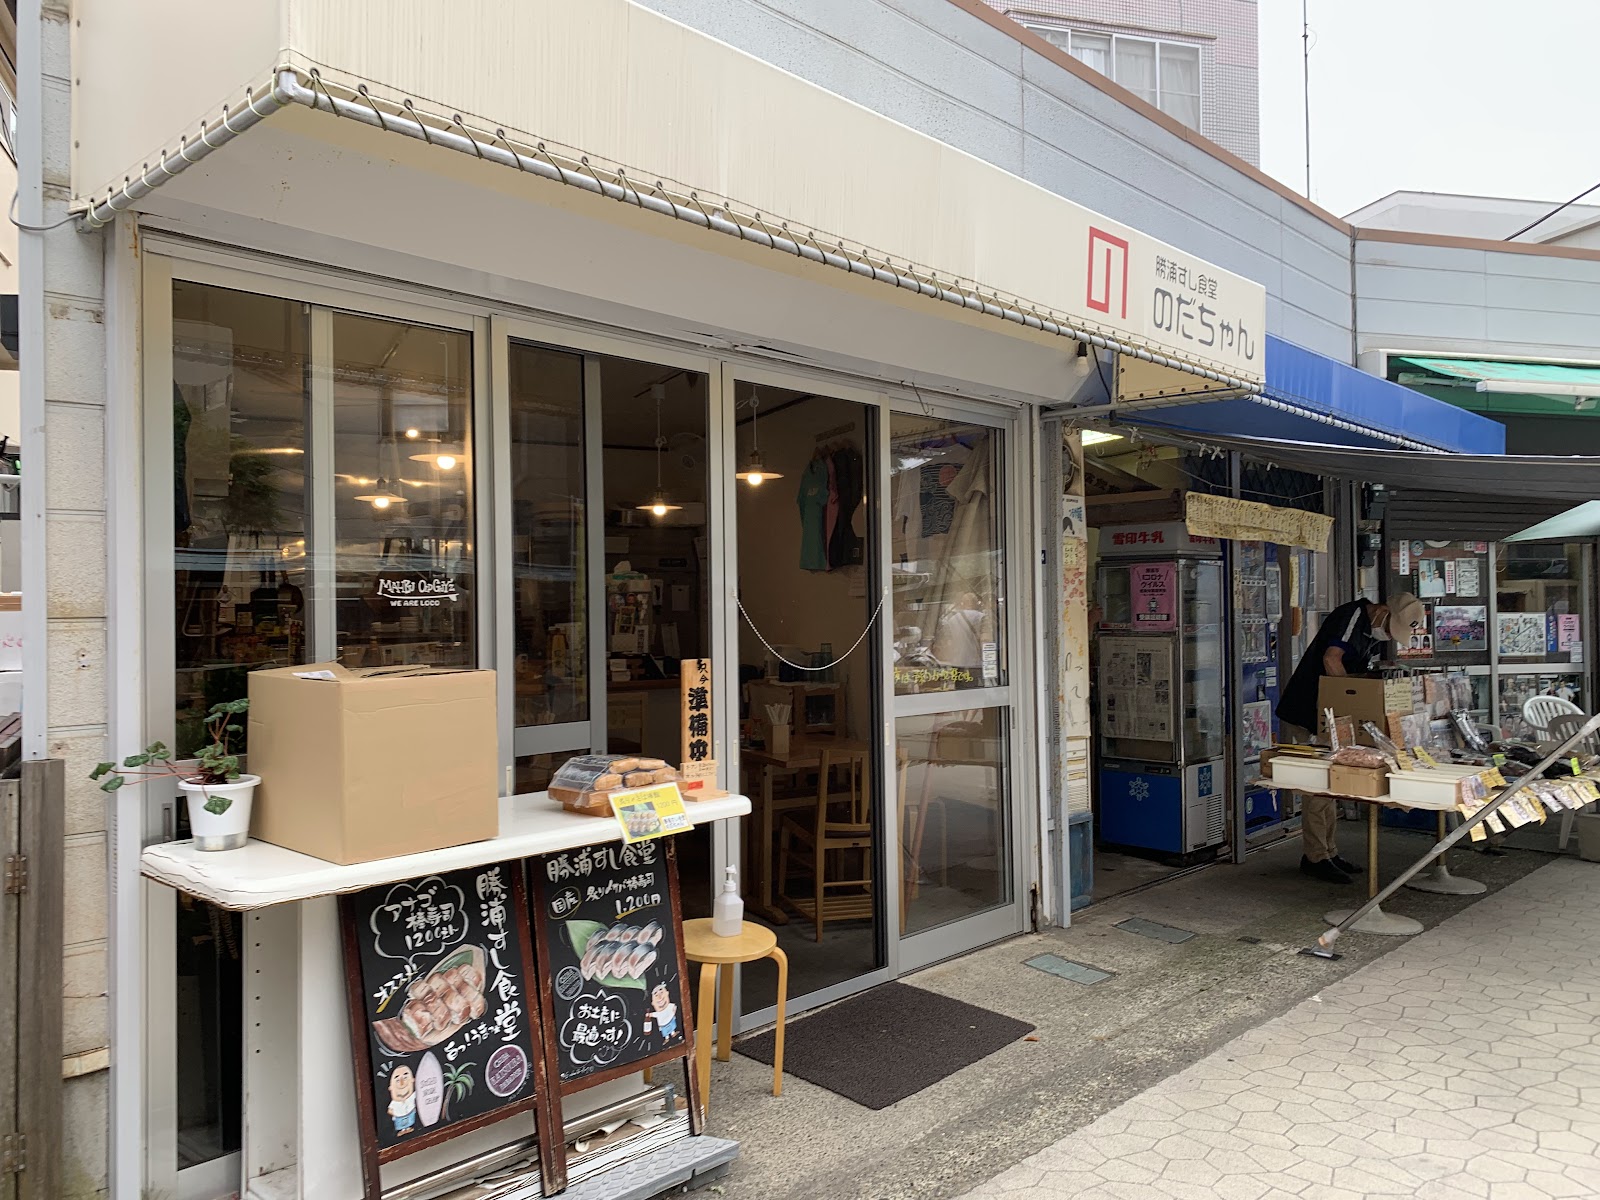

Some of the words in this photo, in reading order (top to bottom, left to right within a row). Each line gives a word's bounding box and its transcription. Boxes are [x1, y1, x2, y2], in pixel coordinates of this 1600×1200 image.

[1155, 255, 1218, 300] 勝浦すし食堂
[1153, 287, 1255, 361] のだちゃん
[1112, 531, 1165, 545] 雪印牛乳
[546, 840, 658, 884] 勝浦すし食堂
[383, 885, 438, 923] アナゴ
[405, 902, 455, 932] 棒寿司
[551, 891, 579, 915] 国産
[476, 866, 522, 1042] 勝浦すし食堂
[577, 1003, 621, 1025] お土産に
